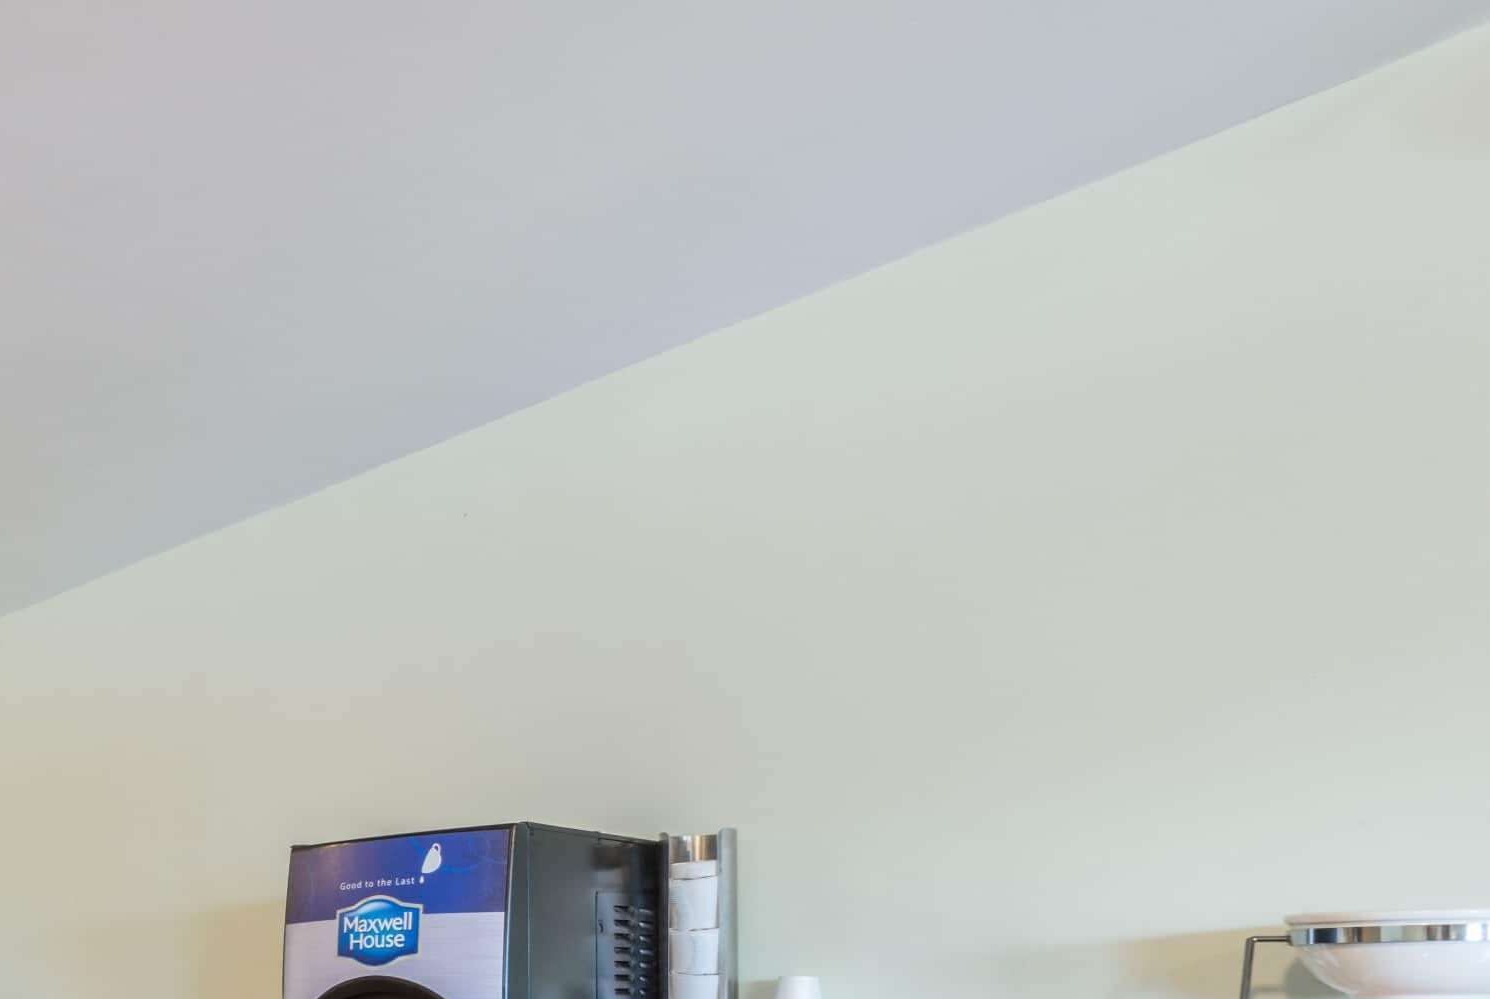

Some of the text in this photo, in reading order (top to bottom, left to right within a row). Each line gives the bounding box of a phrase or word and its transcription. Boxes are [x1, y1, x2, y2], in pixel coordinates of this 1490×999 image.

[339, 877, 415, 890] Good to the Last
[343, 911, 413, 933] Maxwell
[349, 933, 406, 950] House
